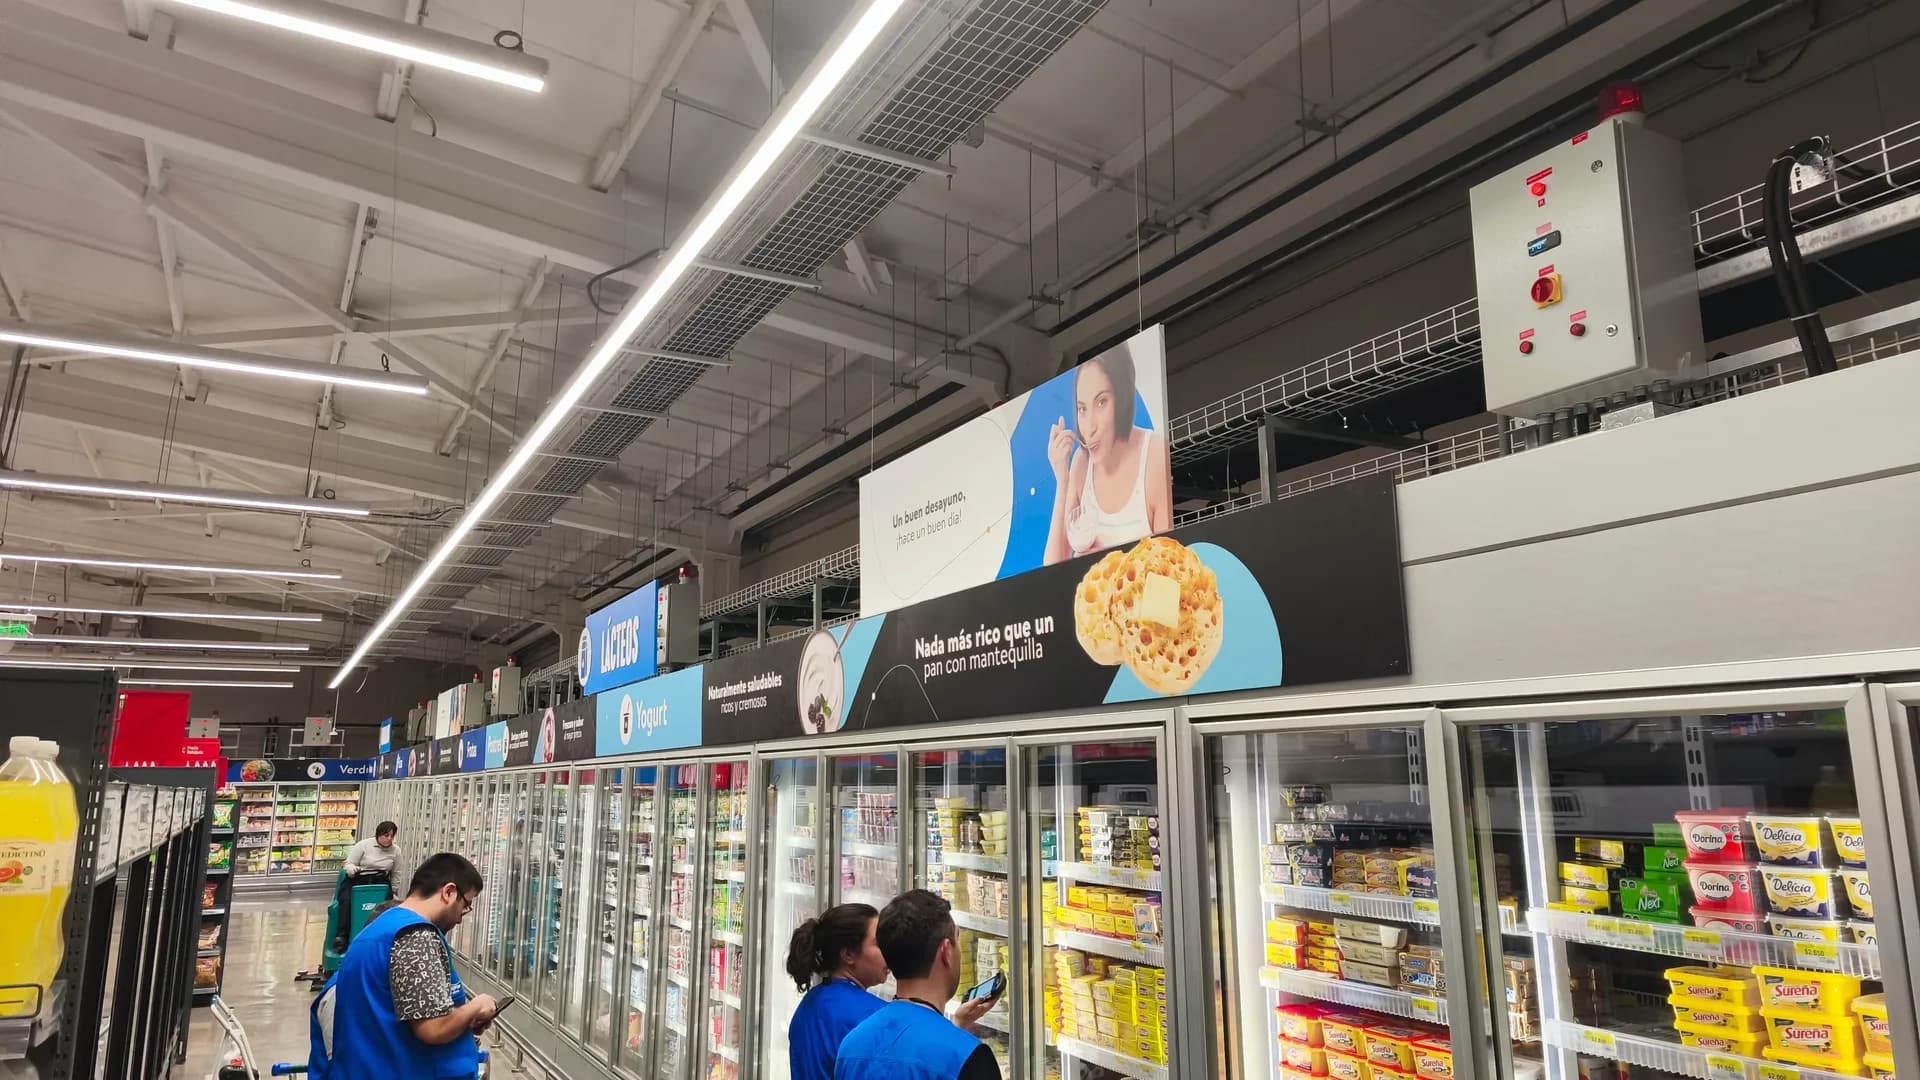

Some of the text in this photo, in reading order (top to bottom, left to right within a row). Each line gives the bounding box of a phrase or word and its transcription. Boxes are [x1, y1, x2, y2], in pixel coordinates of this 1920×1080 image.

[893, 491, 966, 528] Un buen desayuno,
[917, 527, 926, 539] un
[928, 519, 946, 535] buen
[601, 615, 640, 674] LÁCTEOS
[914, 615, 1054, 660] Nada más rico que un
[924, 637, 1043, 684] pan con mantequilla
[708, 671, 782, 701] Naturalmente saludables
[721, 699, 734, 714] ricos
[739, 695, 767, 711] cremosos
[636, 698, 668, 737] Yogurt
[1663, 857, 1679, 868] Next
[1638, 896, 1661, 911] Next
[1774, 983, 1818, 997] Sureña
[1784, 1026, 1829, 1040] Sureña
